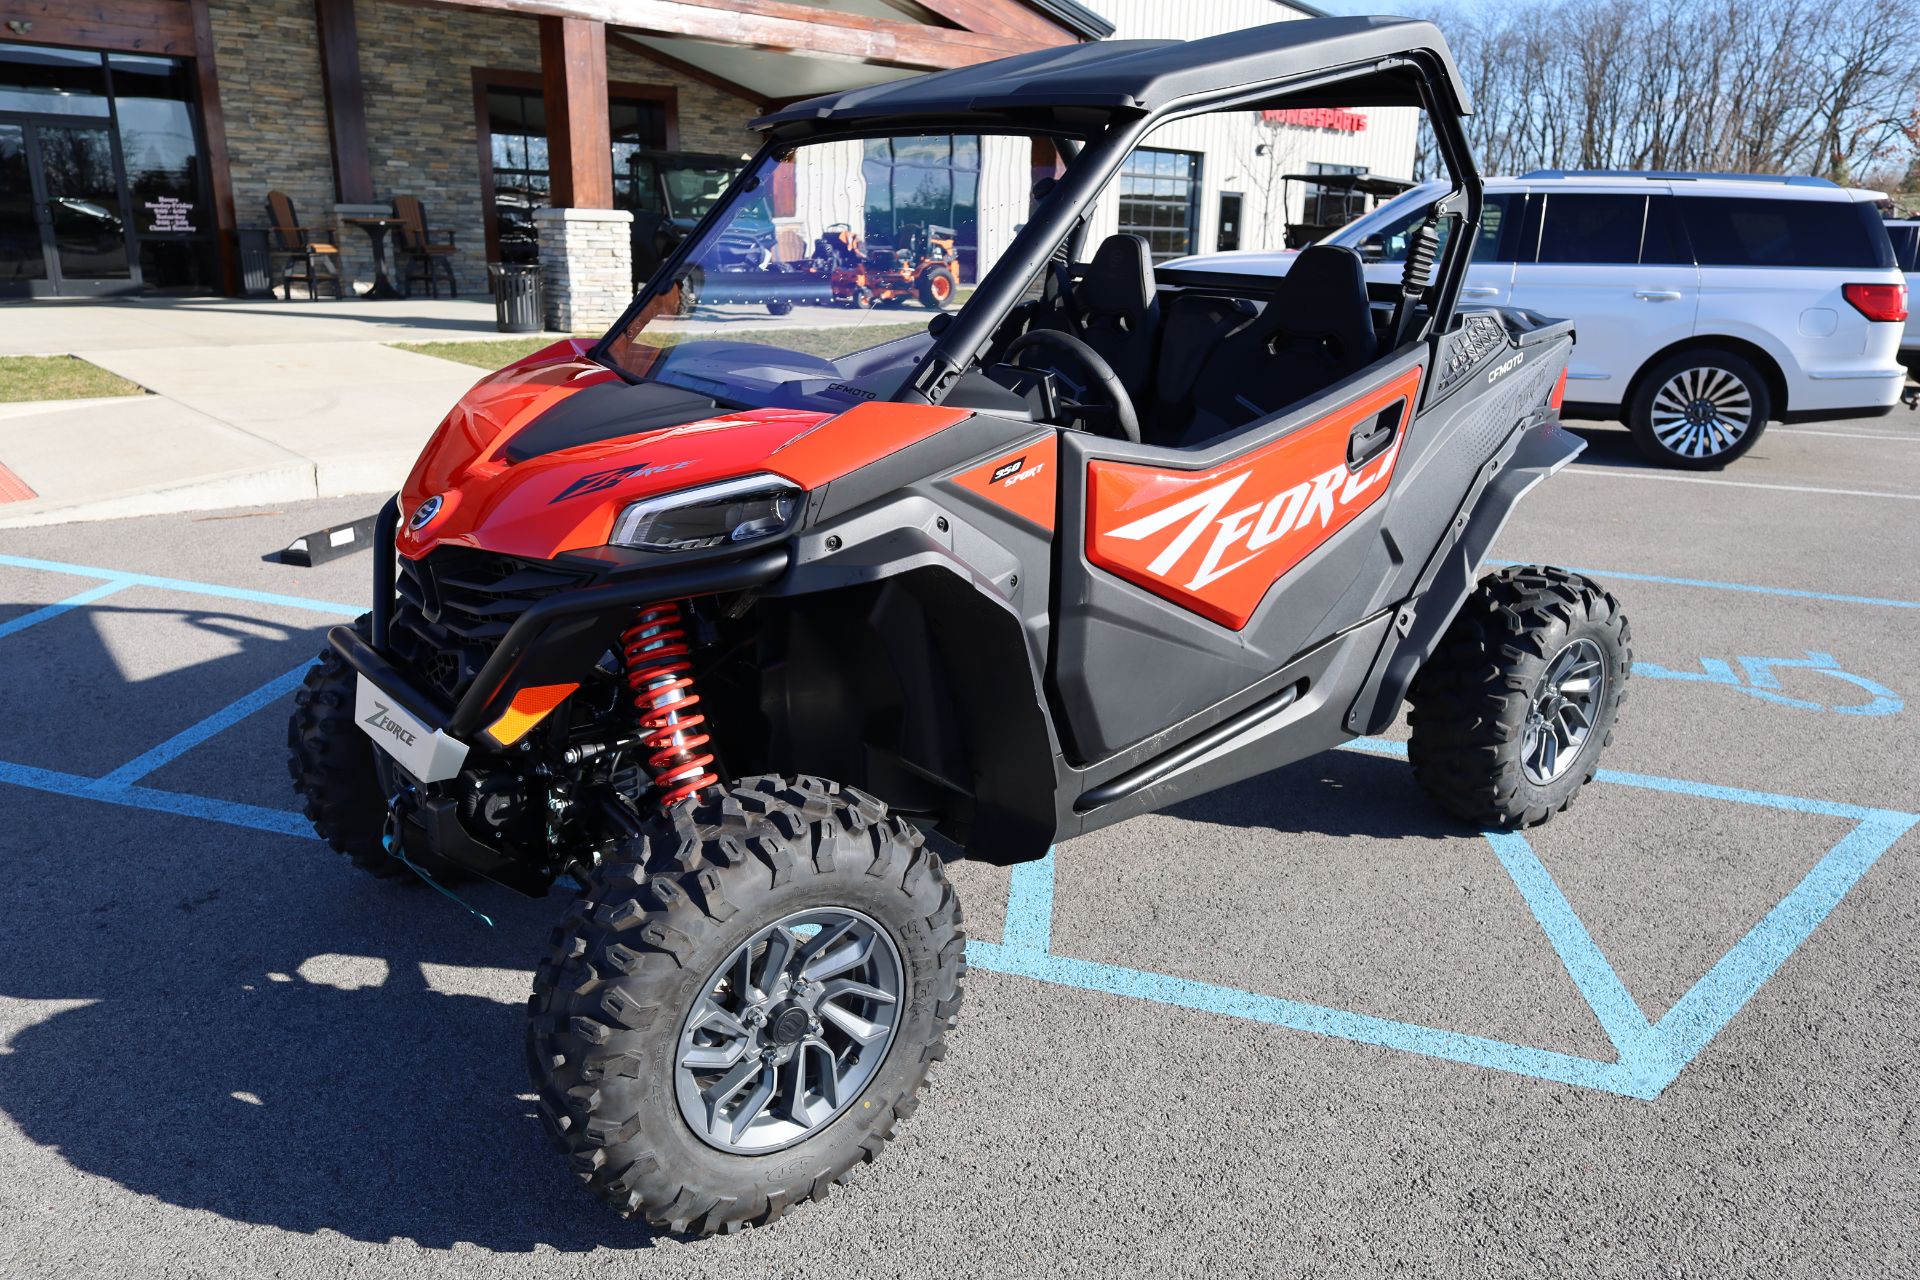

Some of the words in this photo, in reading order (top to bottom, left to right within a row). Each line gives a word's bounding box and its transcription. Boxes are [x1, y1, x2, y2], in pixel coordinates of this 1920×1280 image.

[1262, 107, 1368, 132] POWERSPORTS
[1488, 351, 1524, 384] CFMOTO
[827, 382, 877, 400] CFMOTO
[994, 461, 1022, 480] 950
[1003, 462, 1046, 488] SPORT
[364, 700, 417, 747] ZFORCE
